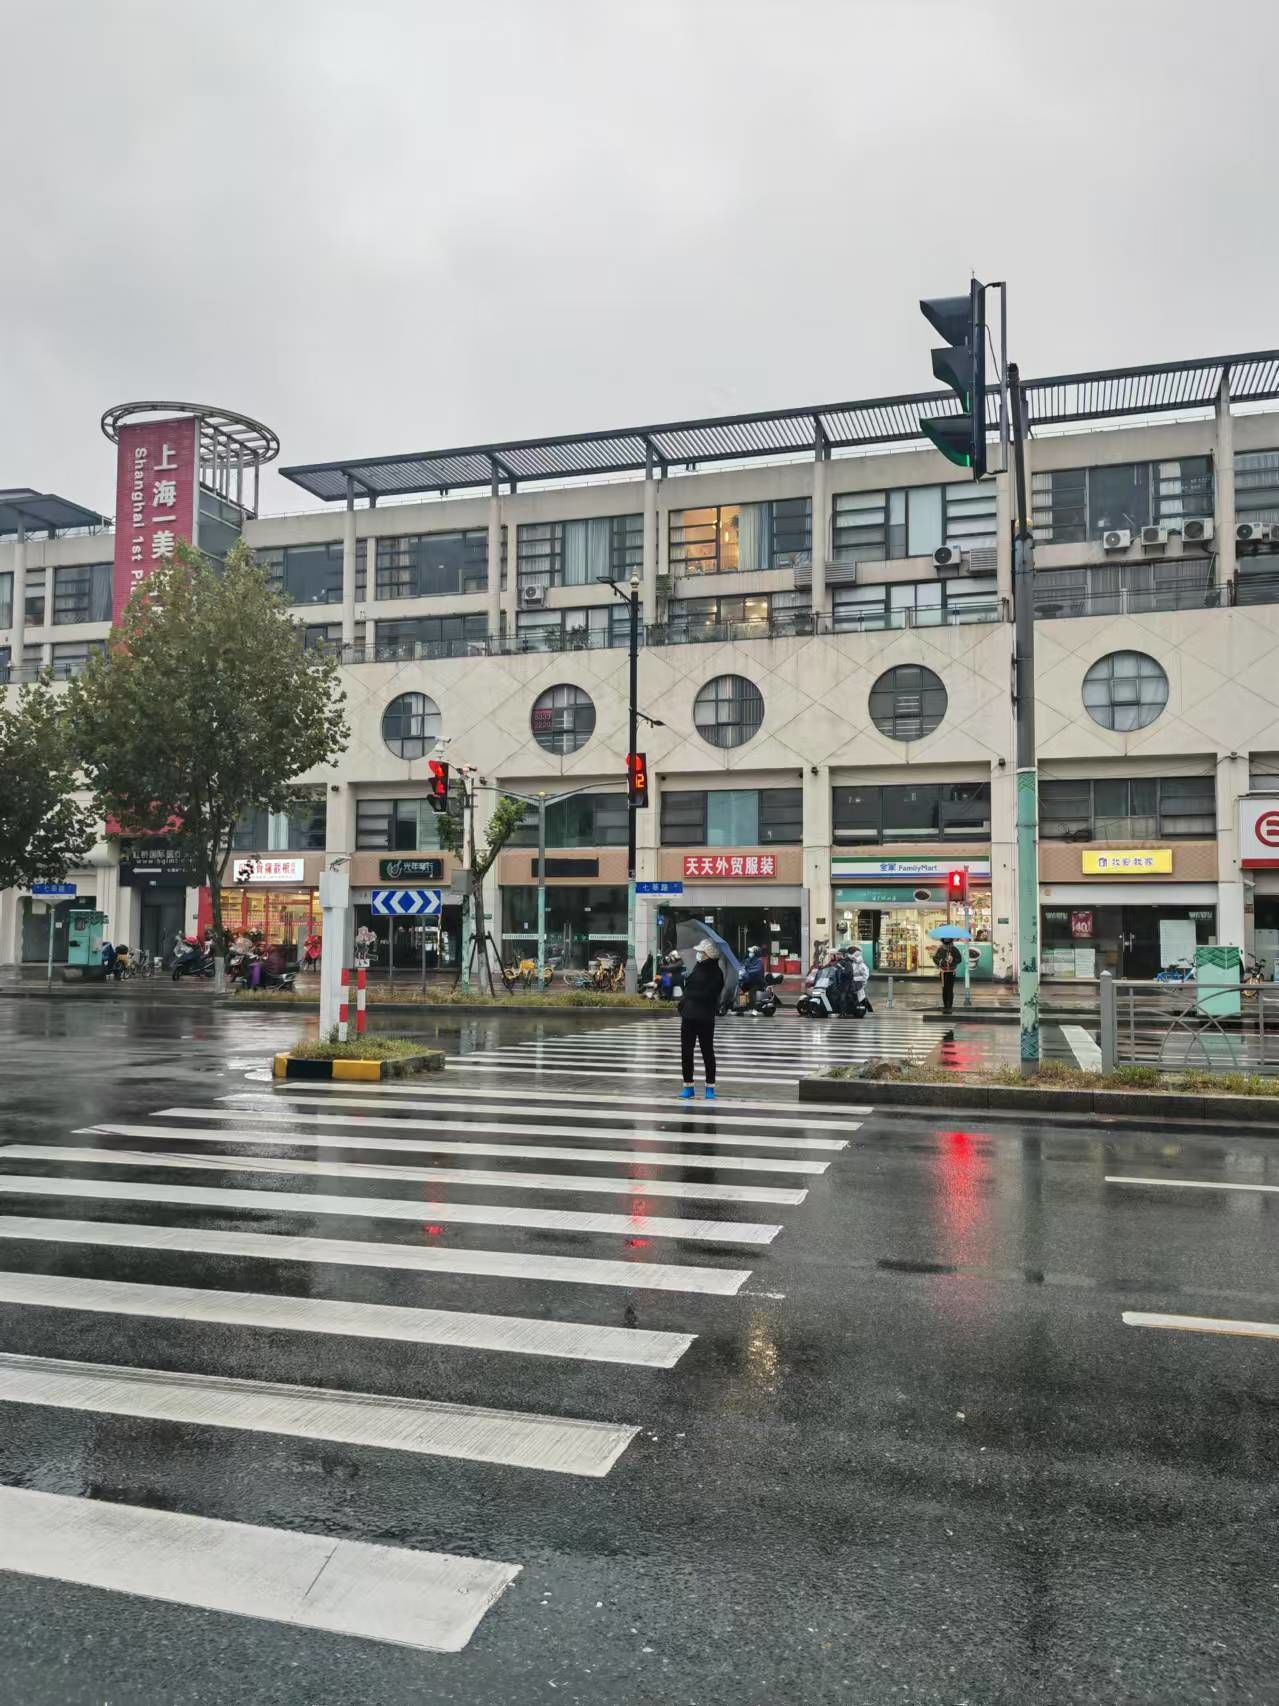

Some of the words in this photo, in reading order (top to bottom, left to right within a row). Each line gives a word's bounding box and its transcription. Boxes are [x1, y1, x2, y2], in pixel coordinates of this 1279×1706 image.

[131, 447, 147, 527] Shanghai
[131, 535, 144, 561] 1st
[686, 856, 775, 876] 天天外贸服装
[898, 864, 938, 873] FamilyMart
